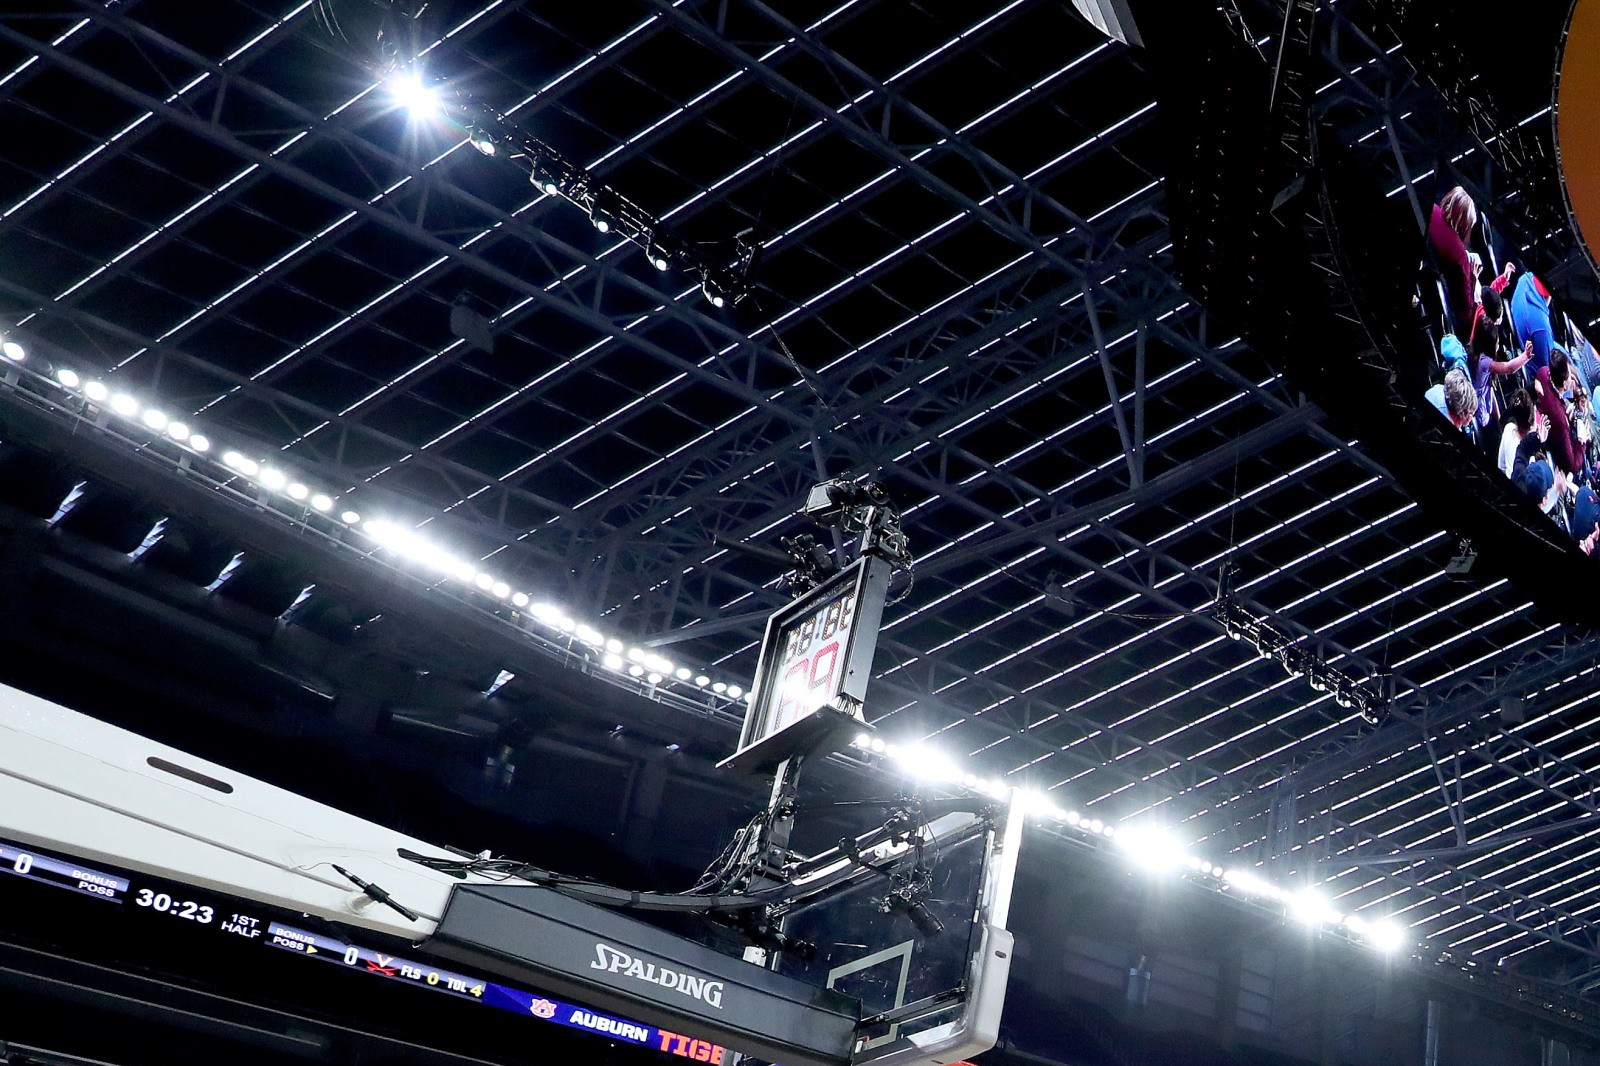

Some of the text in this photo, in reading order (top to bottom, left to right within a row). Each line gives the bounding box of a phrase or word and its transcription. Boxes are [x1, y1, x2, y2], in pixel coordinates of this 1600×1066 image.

[14, 853, 34, 874] 0
[72, 870, 118, 889] BONUS
[78, 880, 115, 897] POSS
[135, 888, 214, 924] 30:23
[221, 921, 261, 939] HALF
[231, 913, 260, 928] 1ST
[272, 936, 305, 951] POSS
[275, 928, 315, 945] BONUS
[343, 947, 359, 966] 0
[400, 964, 483, 998] FLS 0 TOL 4
[590, 943, 724, 1010] SPALDING
[569, 1010, 724, 1065] AUBURN TIGE
